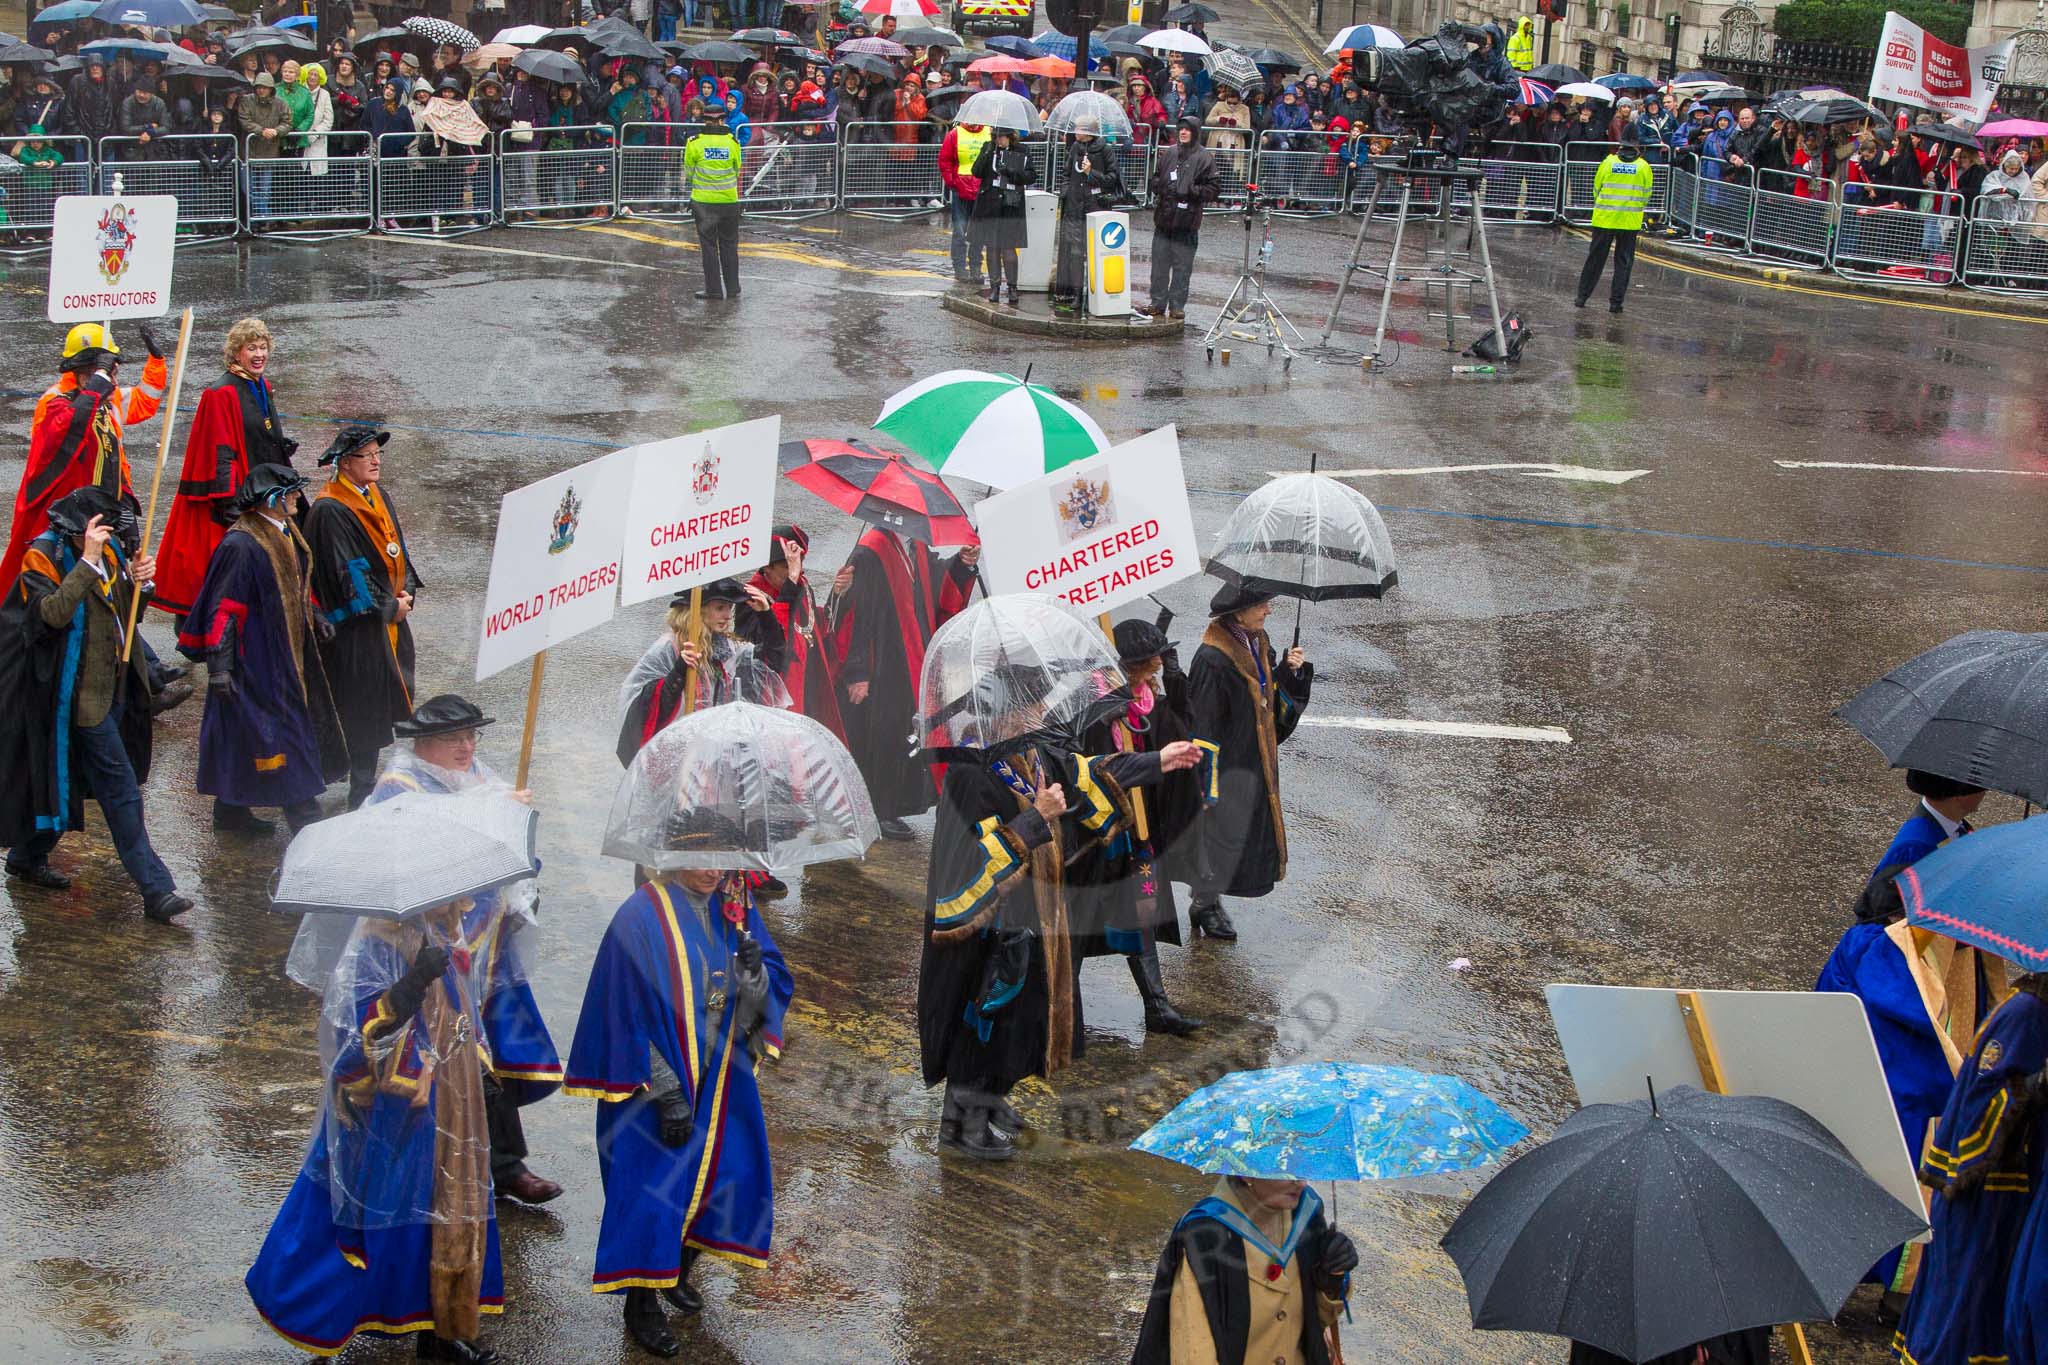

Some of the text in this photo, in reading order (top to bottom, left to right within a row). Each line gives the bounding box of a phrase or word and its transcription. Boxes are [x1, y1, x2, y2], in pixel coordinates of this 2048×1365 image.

[1885, 59, 1914, 72] SURVIVE
[1928, 61, 1960, 79] BOWEL
[1931, 50, 1952, 67] BEAT
[1925, 72, 1964, 89] CANCER
[63, 291, 157, 309] CONSTRUCTORS
[650, 504, 751, 547] CHARTERED
[647, 537, 750, 583] ARCHITECTS
[1025, 519, 1159, 589] CHARTERED
[1057, 549, 1174, 605] RETARIES
[486, 562, 618, 638] WORLD TRADERS
